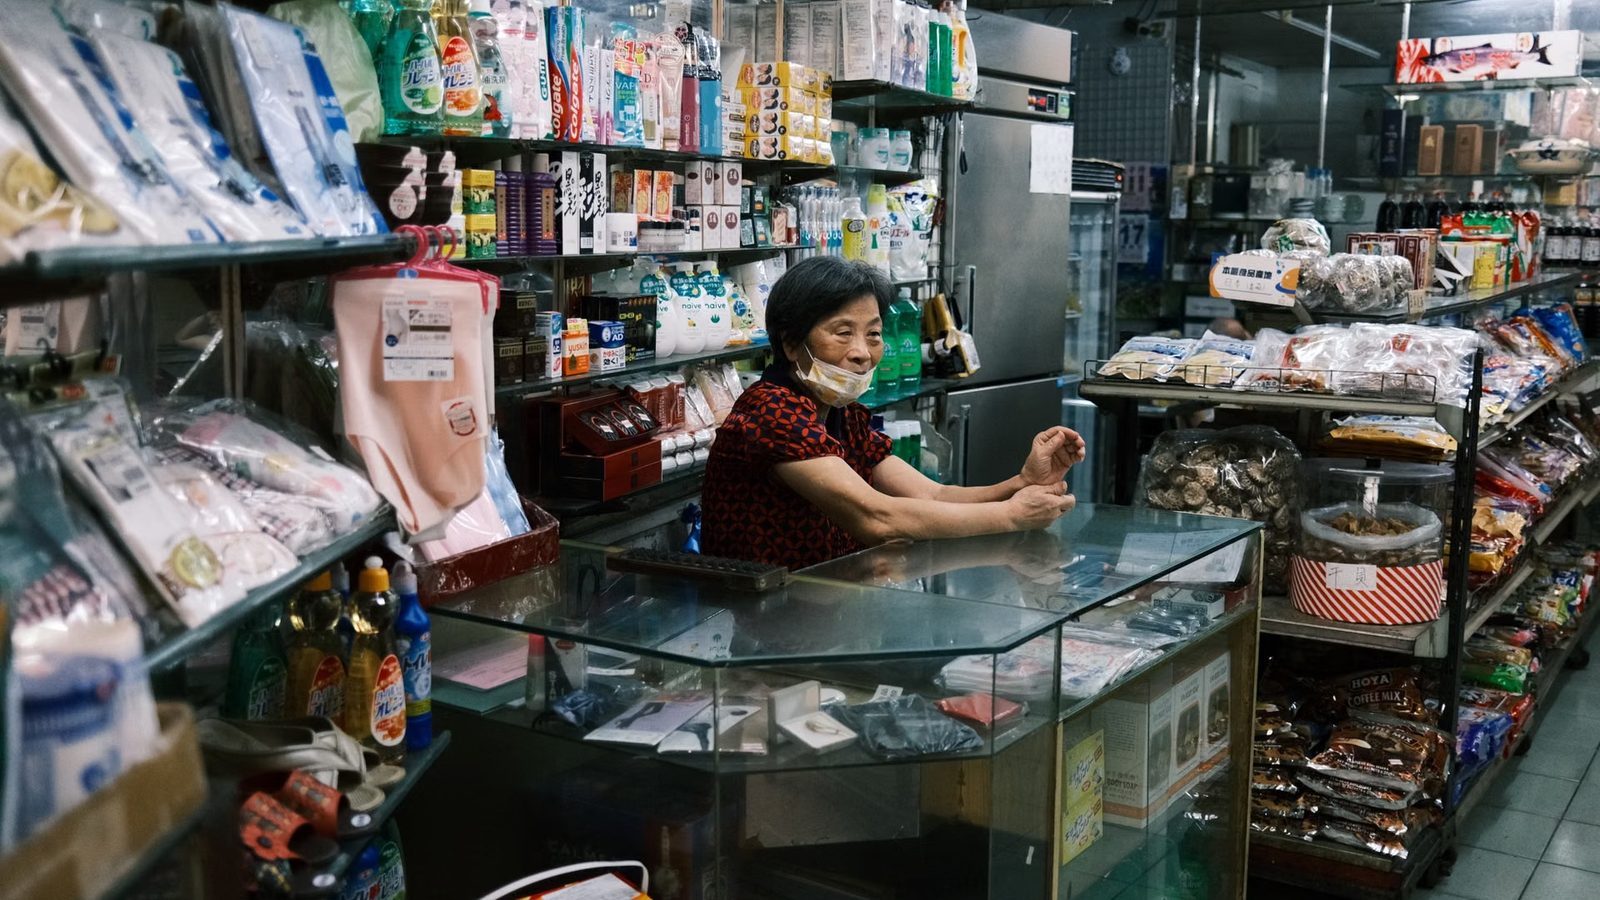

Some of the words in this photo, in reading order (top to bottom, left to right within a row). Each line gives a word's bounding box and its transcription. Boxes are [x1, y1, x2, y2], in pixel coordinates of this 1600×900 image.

[551, 75, 564, 140] Colgate
[569, 60, 580, 140] Colgate
[1119, 224, 1144, 245] 17
[611, 333, 624, 341] AD
[1351, 673, 1389, 689] HOYA
[1348, 691, 1381, 708] COFFEE
[1382, 690, 1402, 702] MIX
